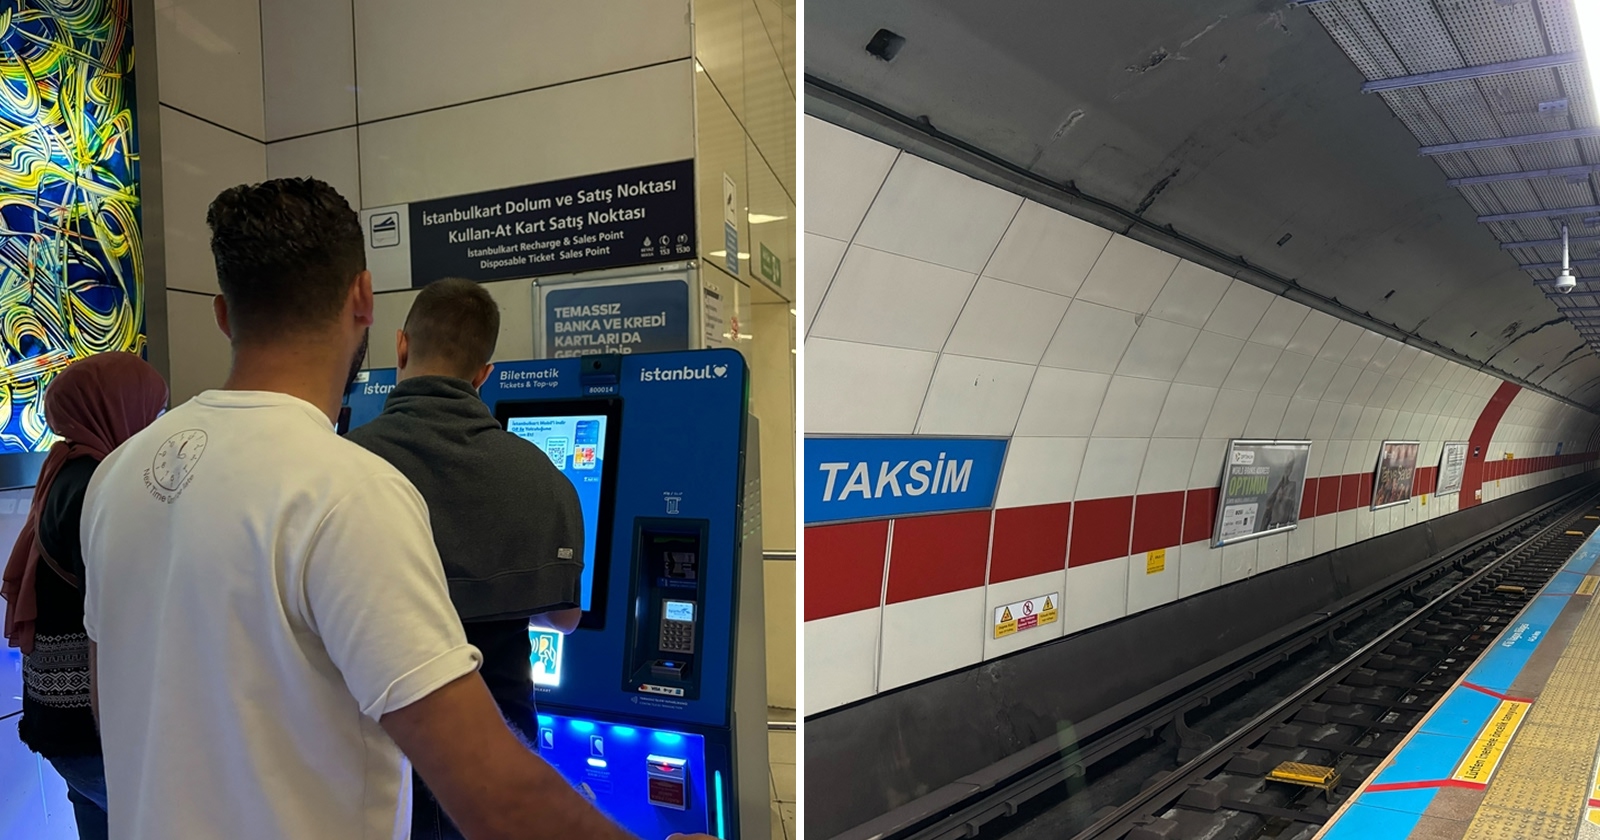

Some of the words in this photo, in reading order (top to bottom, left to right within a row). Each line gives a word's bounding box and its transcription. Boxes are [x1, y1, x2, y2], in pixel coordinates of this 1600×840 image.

[422, 204, 502, 226] İstanbulkart
[505, 198, 551, 215] Dolum
[555, 196, 573, 207] ve
[577, 188, 613, 204] Satış
[617, 179, 677, 199] Noktası
[448, 224, 512, 243] Kullan-At
[515, 219, 546, 236] Kart
[549, 215, 584, 231] Satış
[587, 207, 646, 226] Noktası
[467, 244, 518, 258] İstanbulkart
[520, 239, 561, 252] Recharge
[563, 237, 571, 246] &
[572, 234, 597, 245] Sales
[598, 230, 625, 242] Point
[675, 246, 691, 254] 1530
[480, 256, 526, 270] Disposable
[528, 252, 555, 264] Ticket
[559, 249, 584, 260] Sales
[585, 246, 611, 257] Point
[554, 303, 621, 318] TEMASSIZ
[554, 320, 601, 333] BANKA
[602, 318, 622, 330] VE
[623, 311, 666, 329] KREDİ
[554, 333, 620, 347] KARTLARI
[621, 332, 641, 344] DA
[500, 368, 559, 380] Biletmatik
[640, 365, 711, 382] istanbul
[499, 381, 524, 389] Tickets
[589, 386, 614, 394] 800014
[143, 468, 152, 488] Next
[149, 485, 167, 503] Time
[818, 452, 974, 502] TAKSİM
[1228, 476, 1269, 496] OPTIMUM
[1464, 760, 1485, 779] Lütfen
[1475, 738, 1498, 759] inenlere
